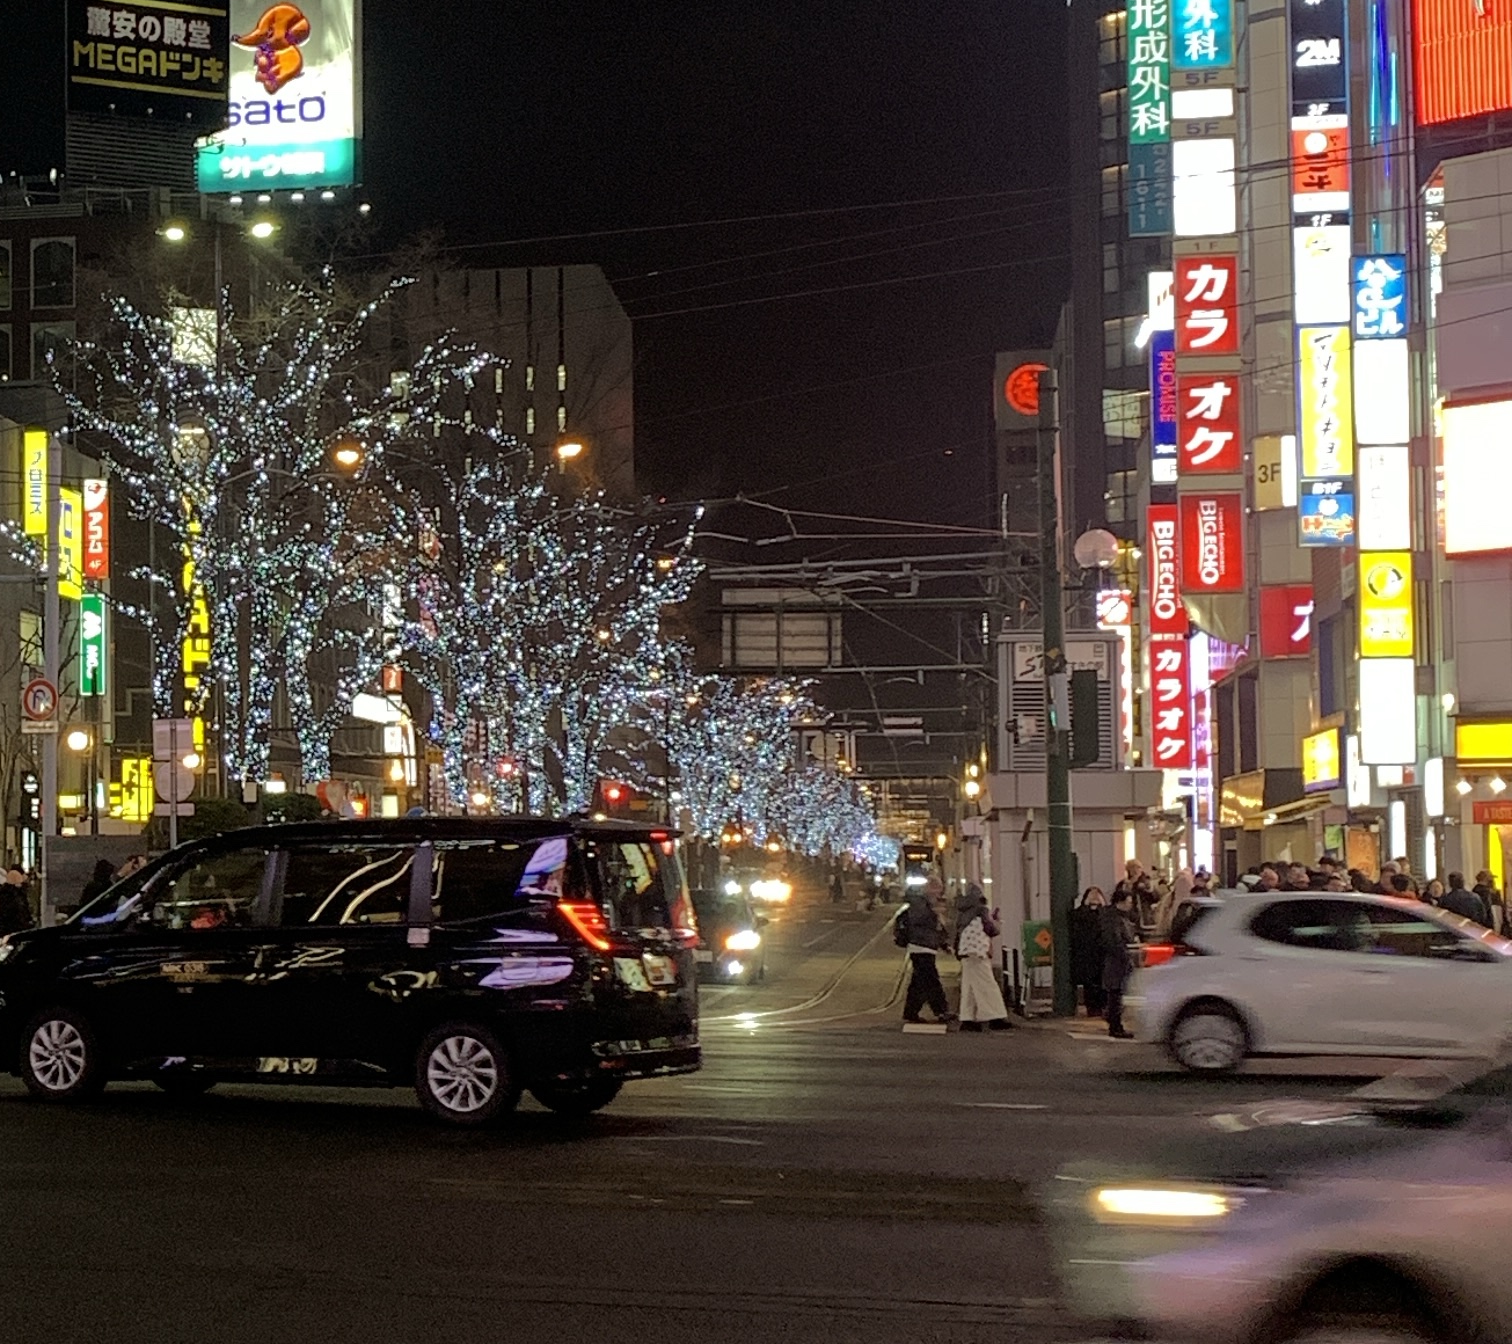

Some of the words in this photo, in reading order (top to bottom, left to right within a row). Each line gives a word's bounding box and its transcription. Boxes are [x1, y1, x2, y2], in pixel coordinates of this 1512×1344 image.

[87, 6, 211, 50] 驚安の殿堂
[73, 40, 225, 84] MEGAドンキ
[1185, 72, 1220, 85] 5F
[228, 96, 325, 127] sato
[1185, 122, 1220, 135] 5F
[1258, 464, 1281, 483] 3F
[88, 511, 104, 554] アコム
[1155, 649, 1185, 760] カラオケ
